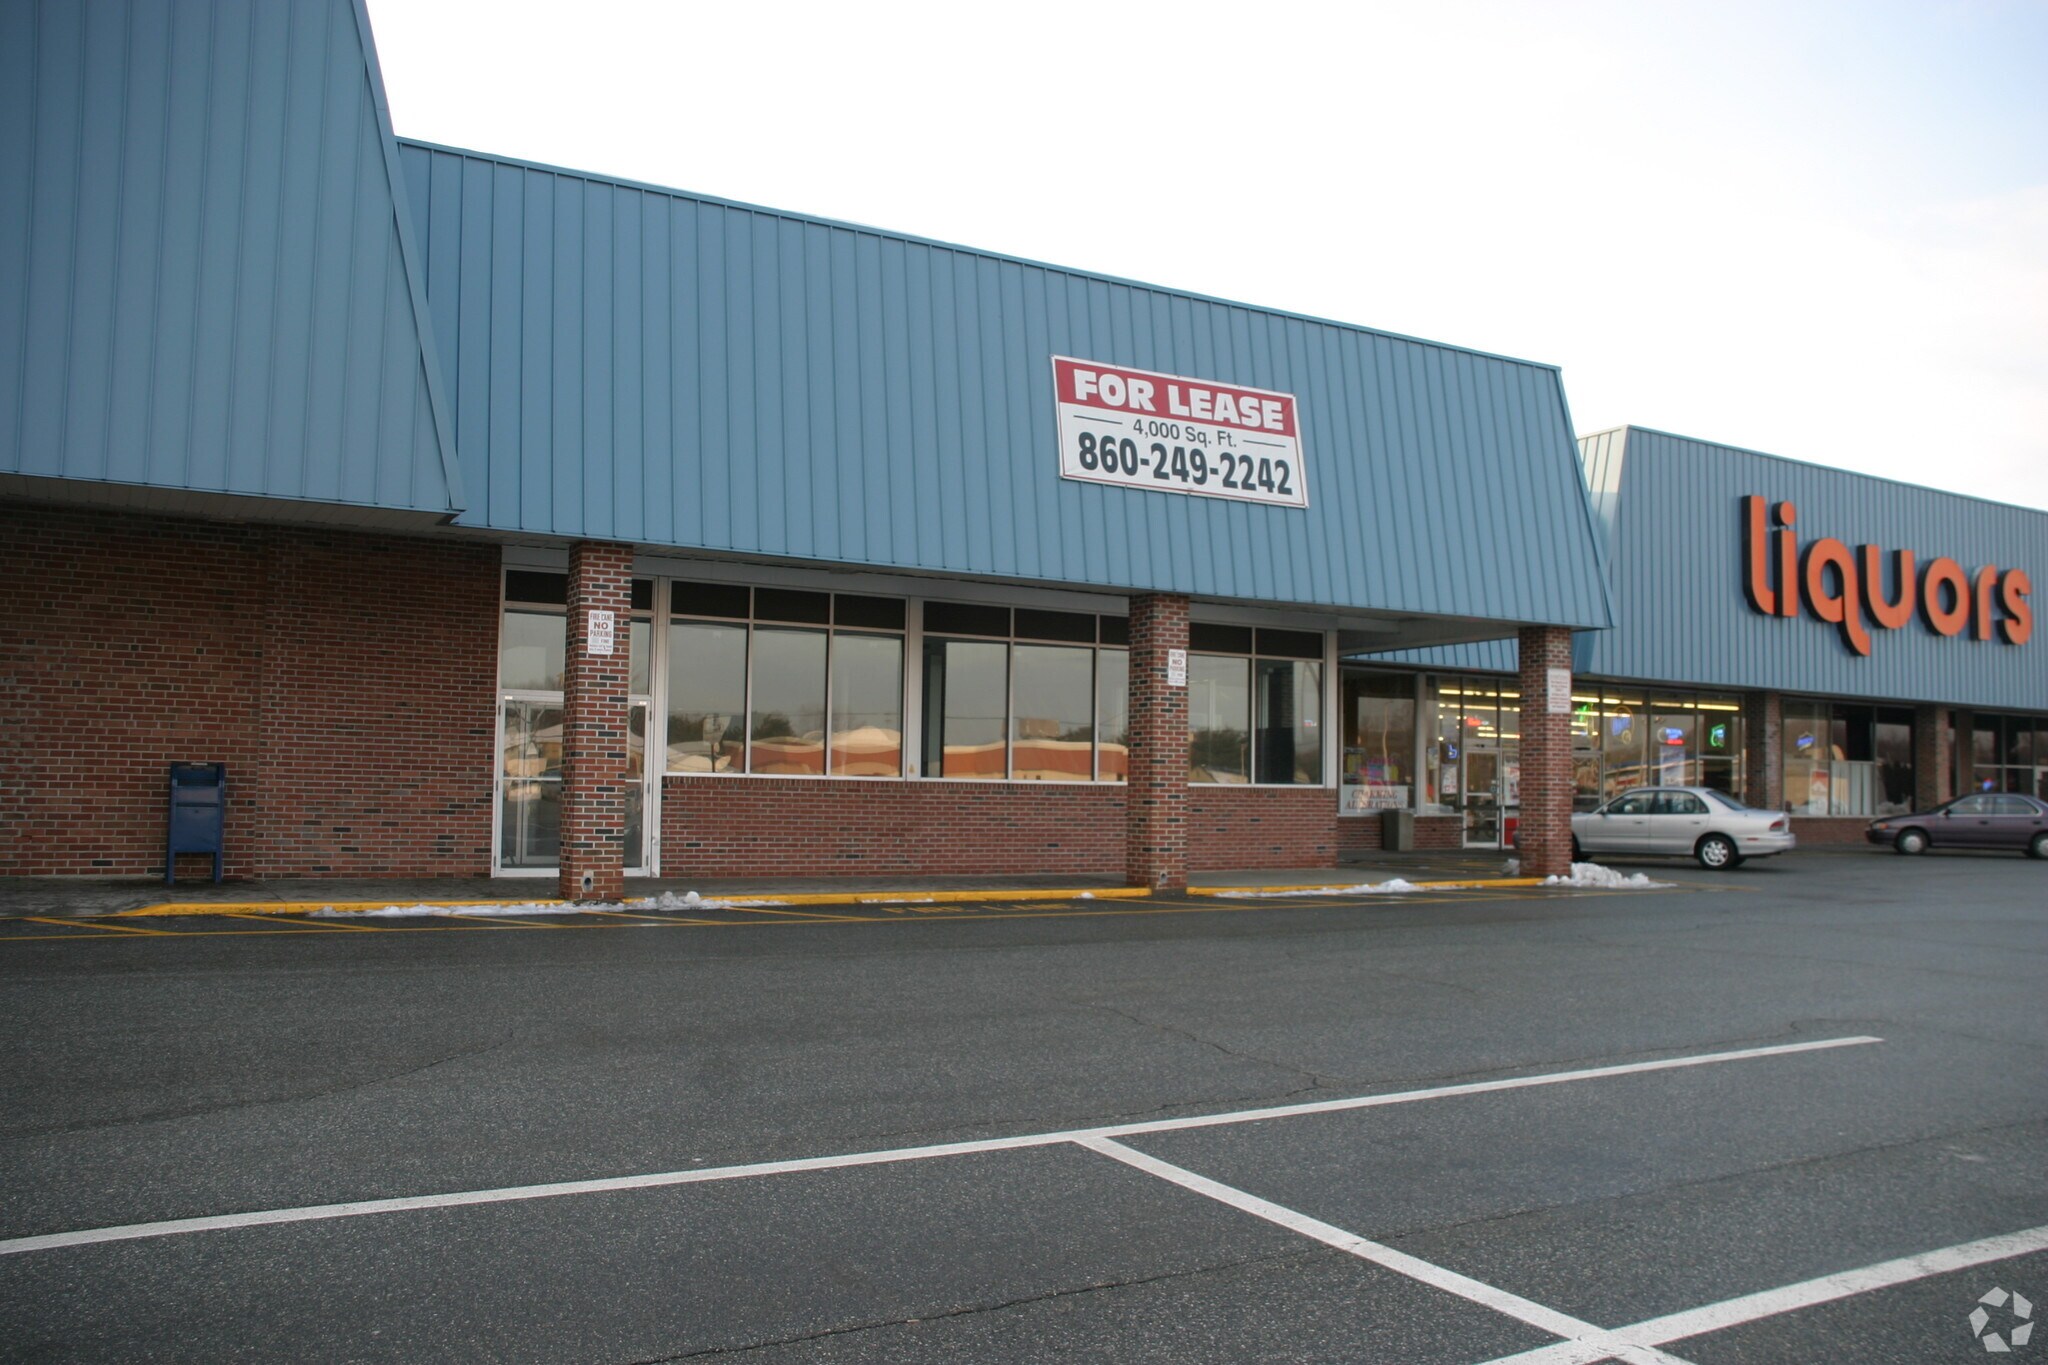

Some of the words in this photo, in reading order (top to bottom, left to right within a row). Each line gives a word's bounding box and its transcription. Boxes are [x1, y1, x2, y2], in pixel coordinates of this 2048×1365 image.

[1073, 368, 1156, 412] FOR
[1167, 384, 1284, 431] LEASE
[1133, 418, 1180, 440] 4,000
[1185, 426, 1212, 448] Sq.
[1217, 430, 1237, 448] Ft.
[1078, 431, 1293, 496] 860-249-2242
[1740, 494, 2033, 657] liquors
[590, 630, 612, 638] PARKING
[593, 622, 609, 630] NO
